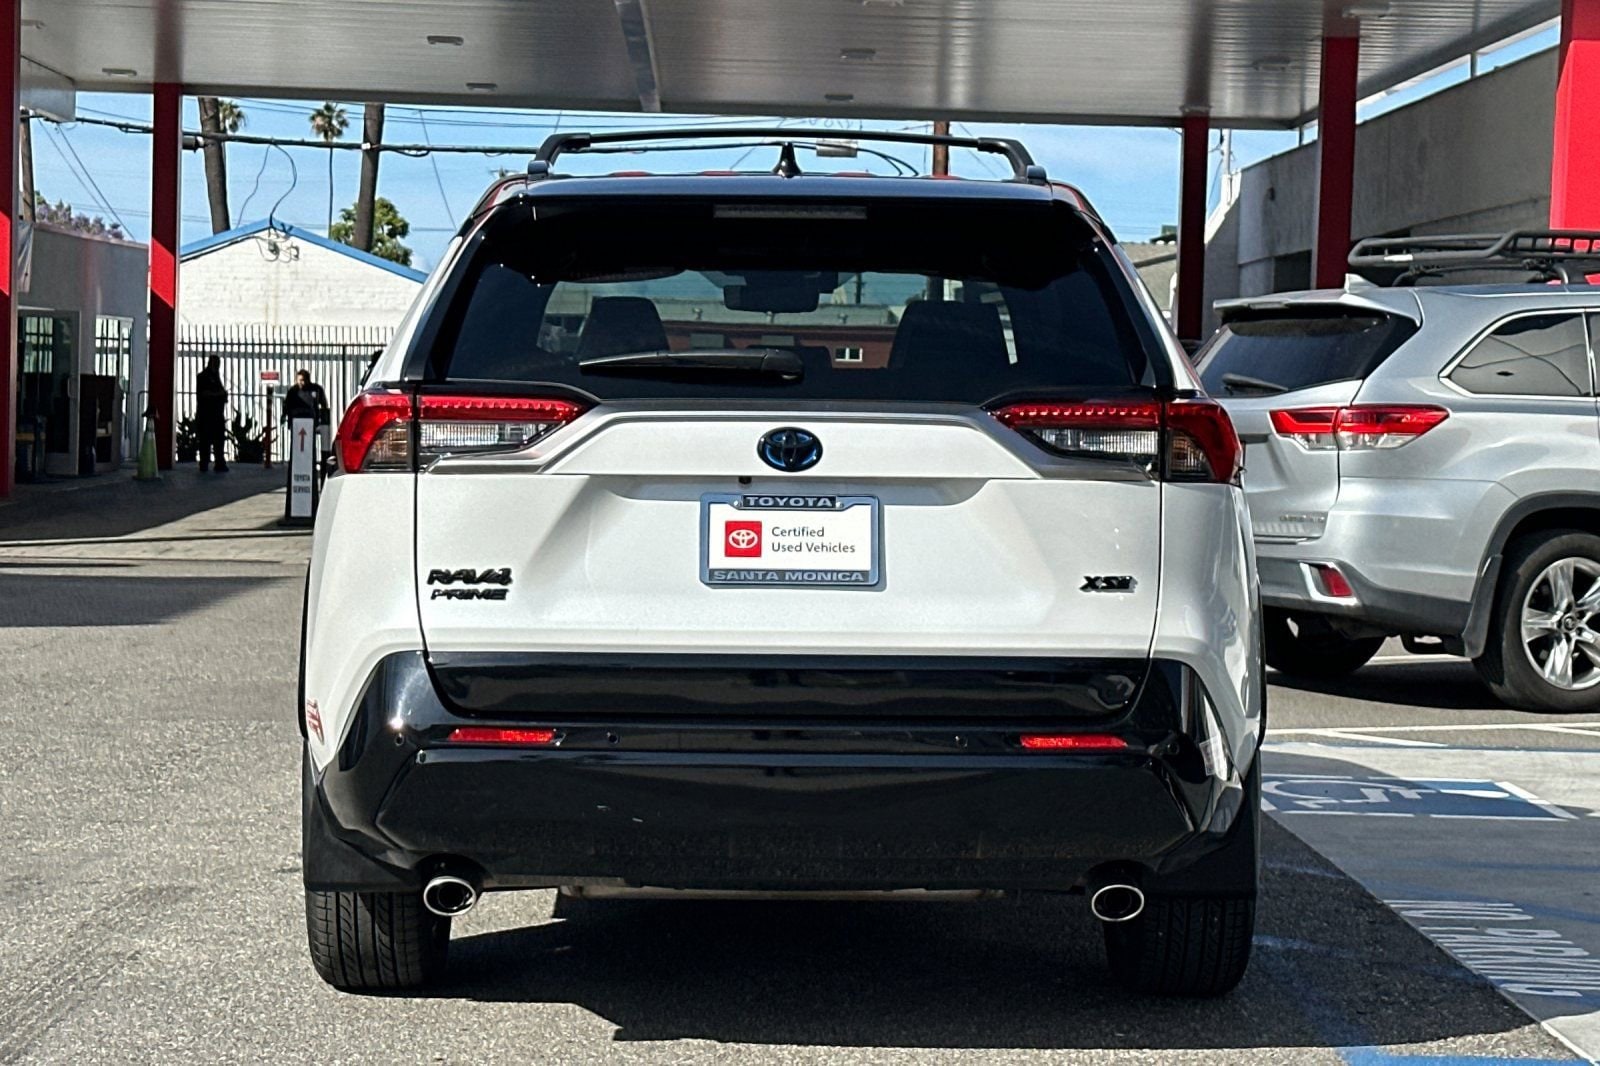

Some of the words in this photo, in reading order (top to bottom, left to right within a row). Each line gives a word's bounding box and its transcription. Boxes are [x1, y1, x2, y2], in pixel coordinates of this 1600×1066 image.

[745, 496, 833, 507] TOYOTA
[771, 526, 825, 537] Certified
[771, 542, 802, 553] Used
[805, 542, 856, 553] Vehicles
[427, 567, 513, 585] RAV4
[713, 570, 779, 581] SANTA
[784, 570, 865, 582] MONICA
[430, 588, 509, 600] PRIME
